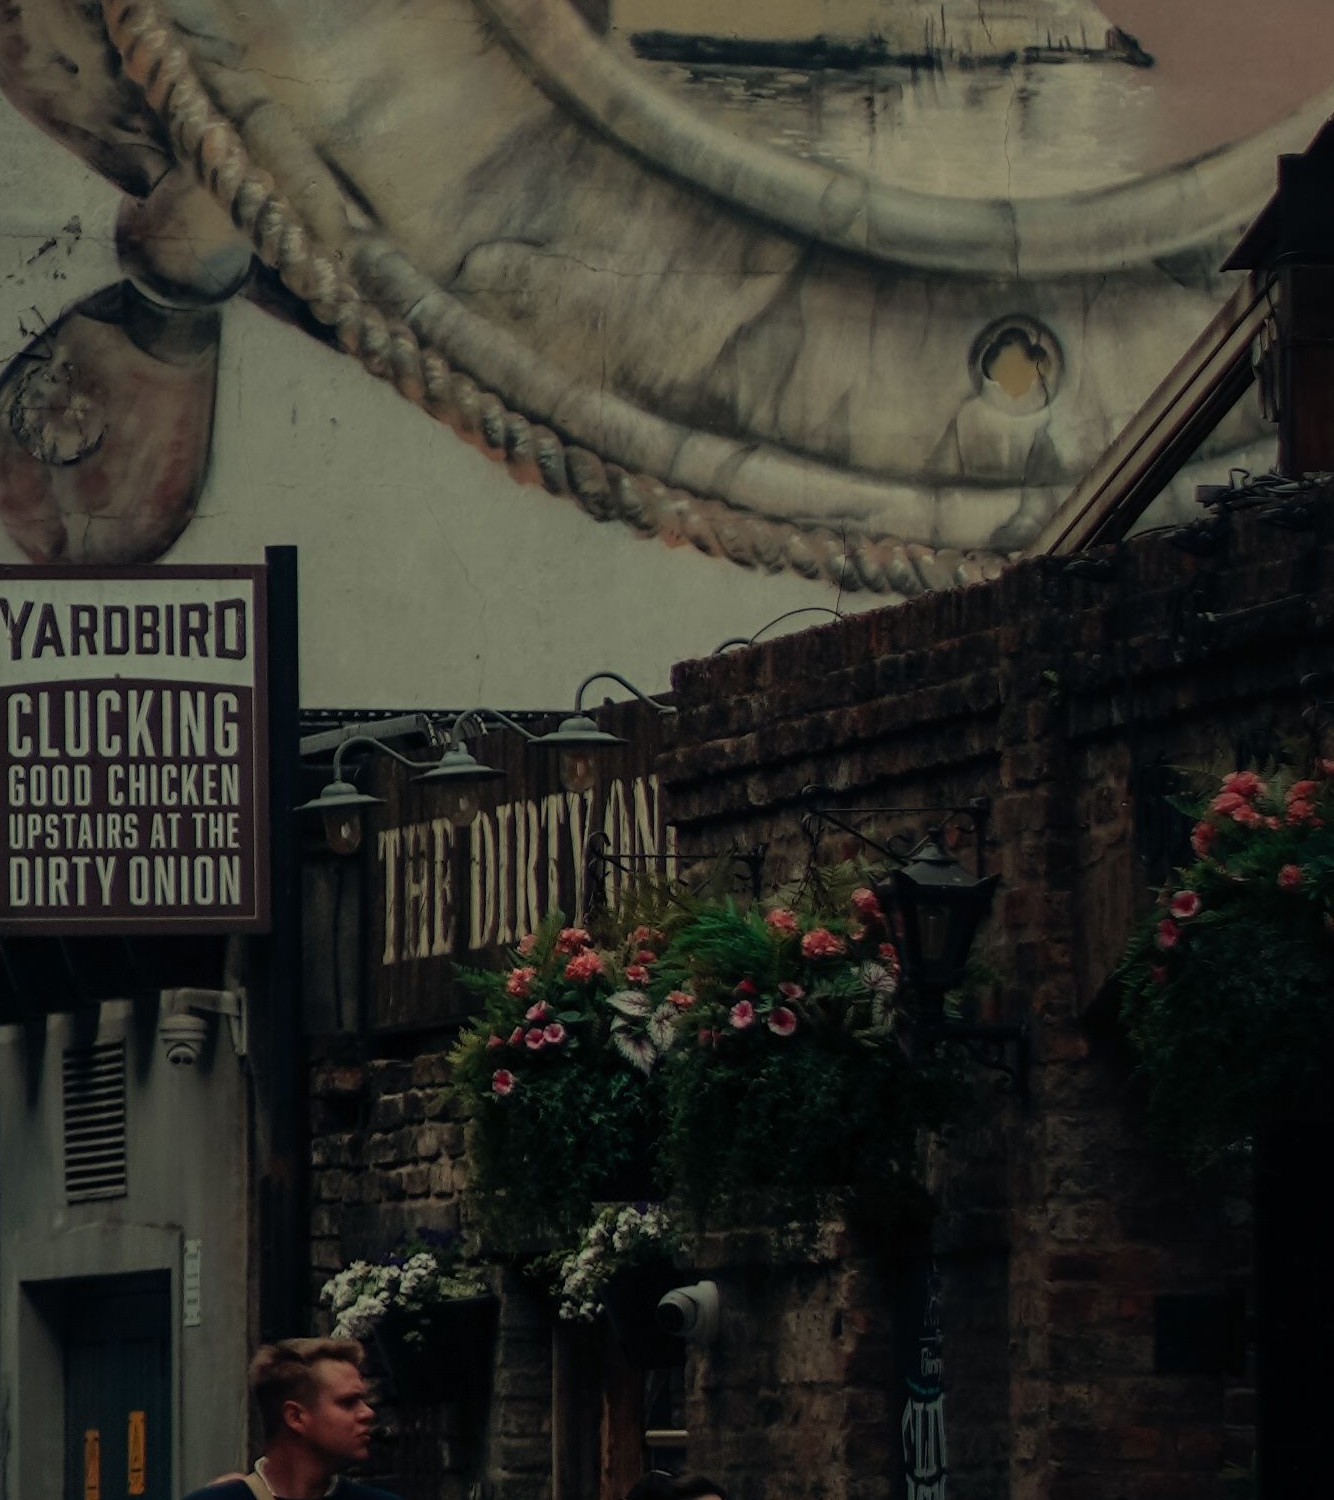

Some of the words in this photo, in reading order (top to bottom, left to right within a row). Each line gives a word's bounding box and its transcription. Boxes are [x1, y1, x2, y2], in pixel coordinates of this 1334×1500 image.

[8, 690, 240, 758] CLUCKING
[8, 764, 91, 806] GOOD
[107, 763, 240, 806] CHICKEN
[9, 812, 139, 850] UPSTAIRS
[149, 812, 186, 849] AT
[193, 812, 241, 849] THE
[9, 856, 115, 907] DIRTY
[129, 856, 241, 906] ONION
[378, 817, 454, 966] THE
[468, 787, 595, 950] DIRTY
